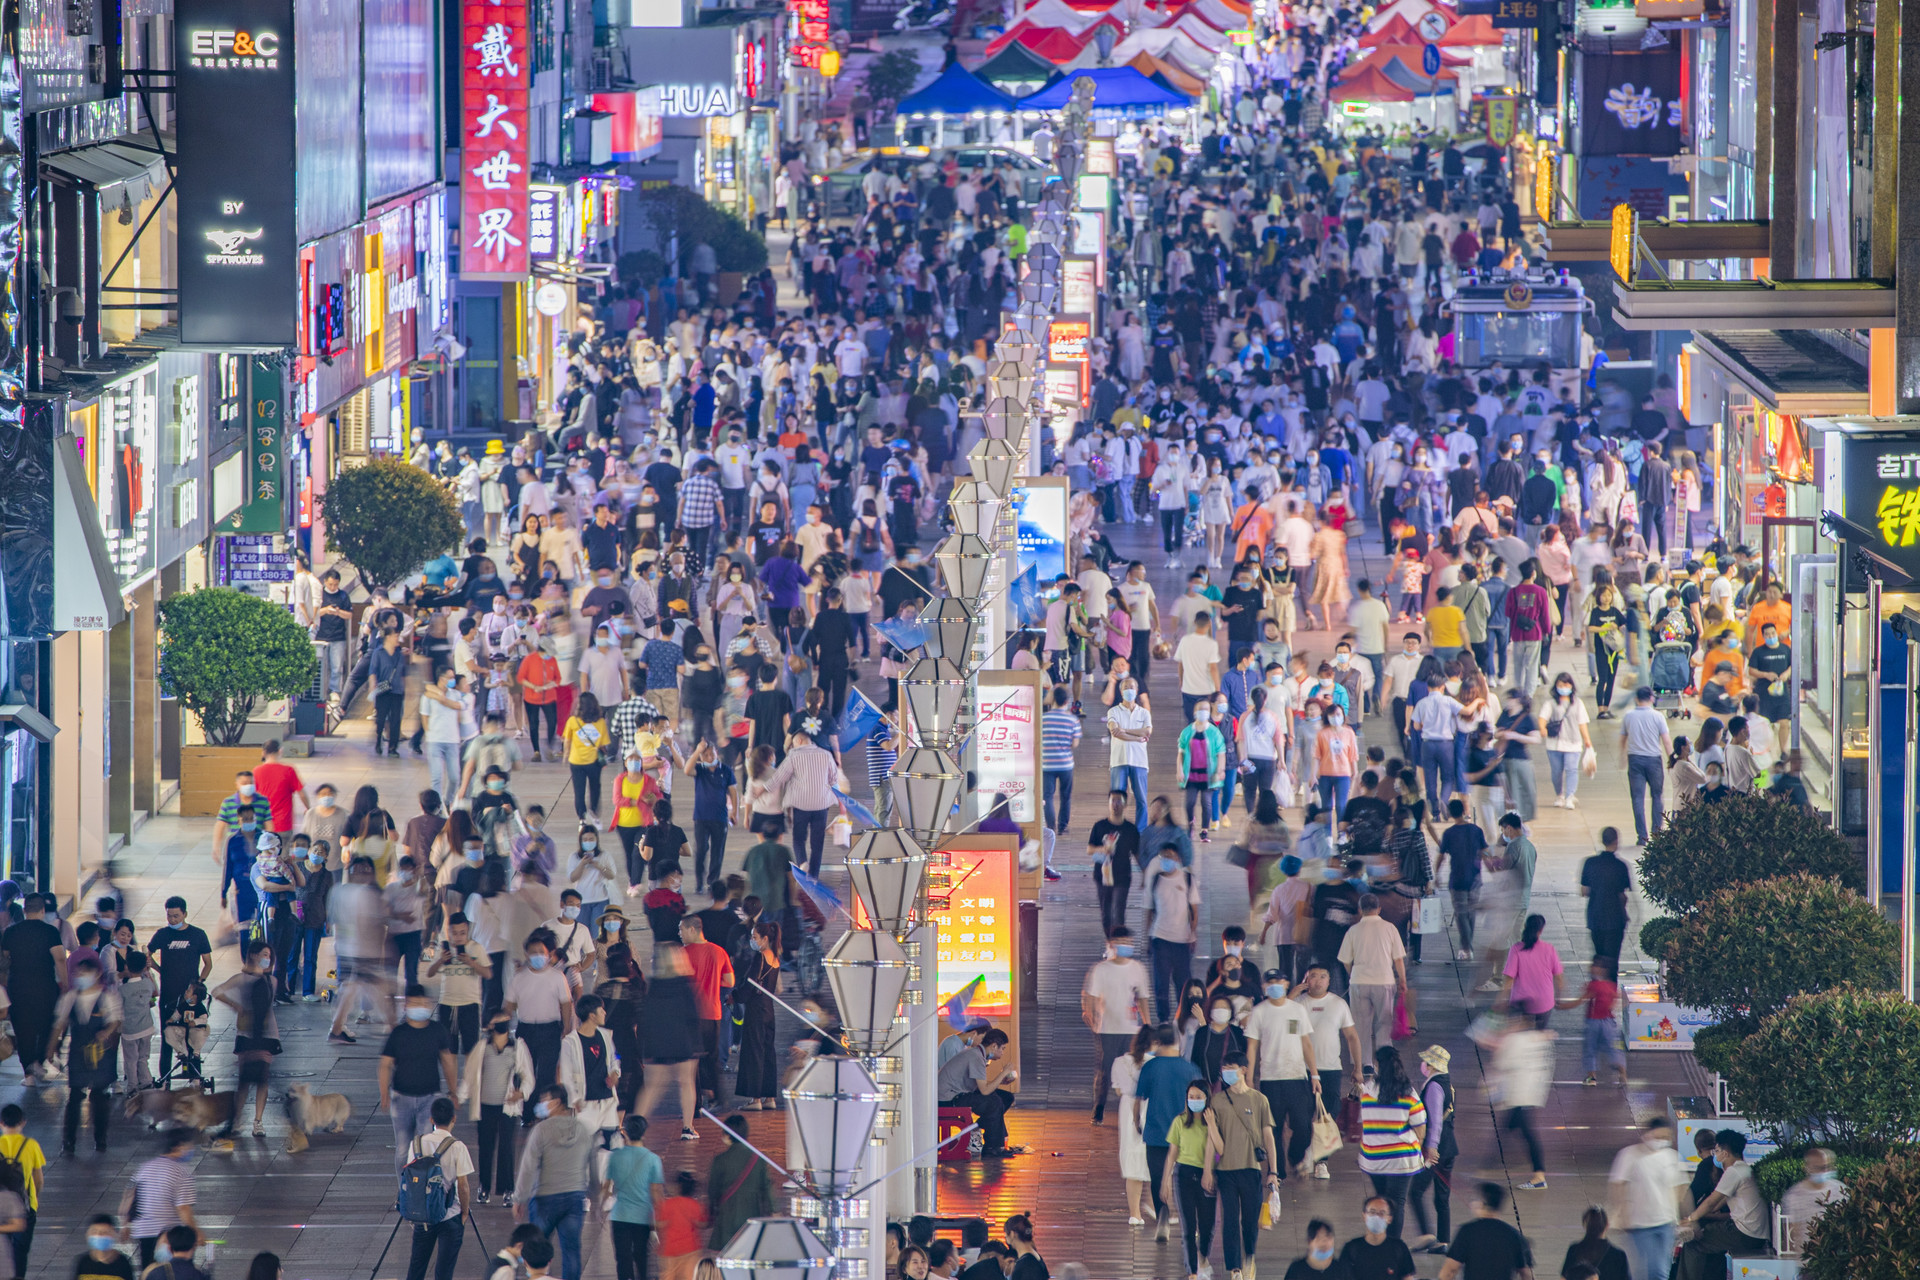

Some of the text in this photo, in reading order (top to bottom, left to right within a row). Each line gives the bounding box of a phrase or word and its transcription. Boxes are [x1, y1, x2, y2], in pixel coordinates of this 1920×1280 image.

[192, 30, 279, 56] EF&C
[660, 85, 736, 116] HUA
[472, 0, 521, 262] 戴大世界
[223, 201, 244, 214] BY
[959, 898, 995, 908] 文明
[960, 916, 995, 926] 平等
[959, 933, 995, 943] 爱国
[959, 951, 995, 961] 友善
